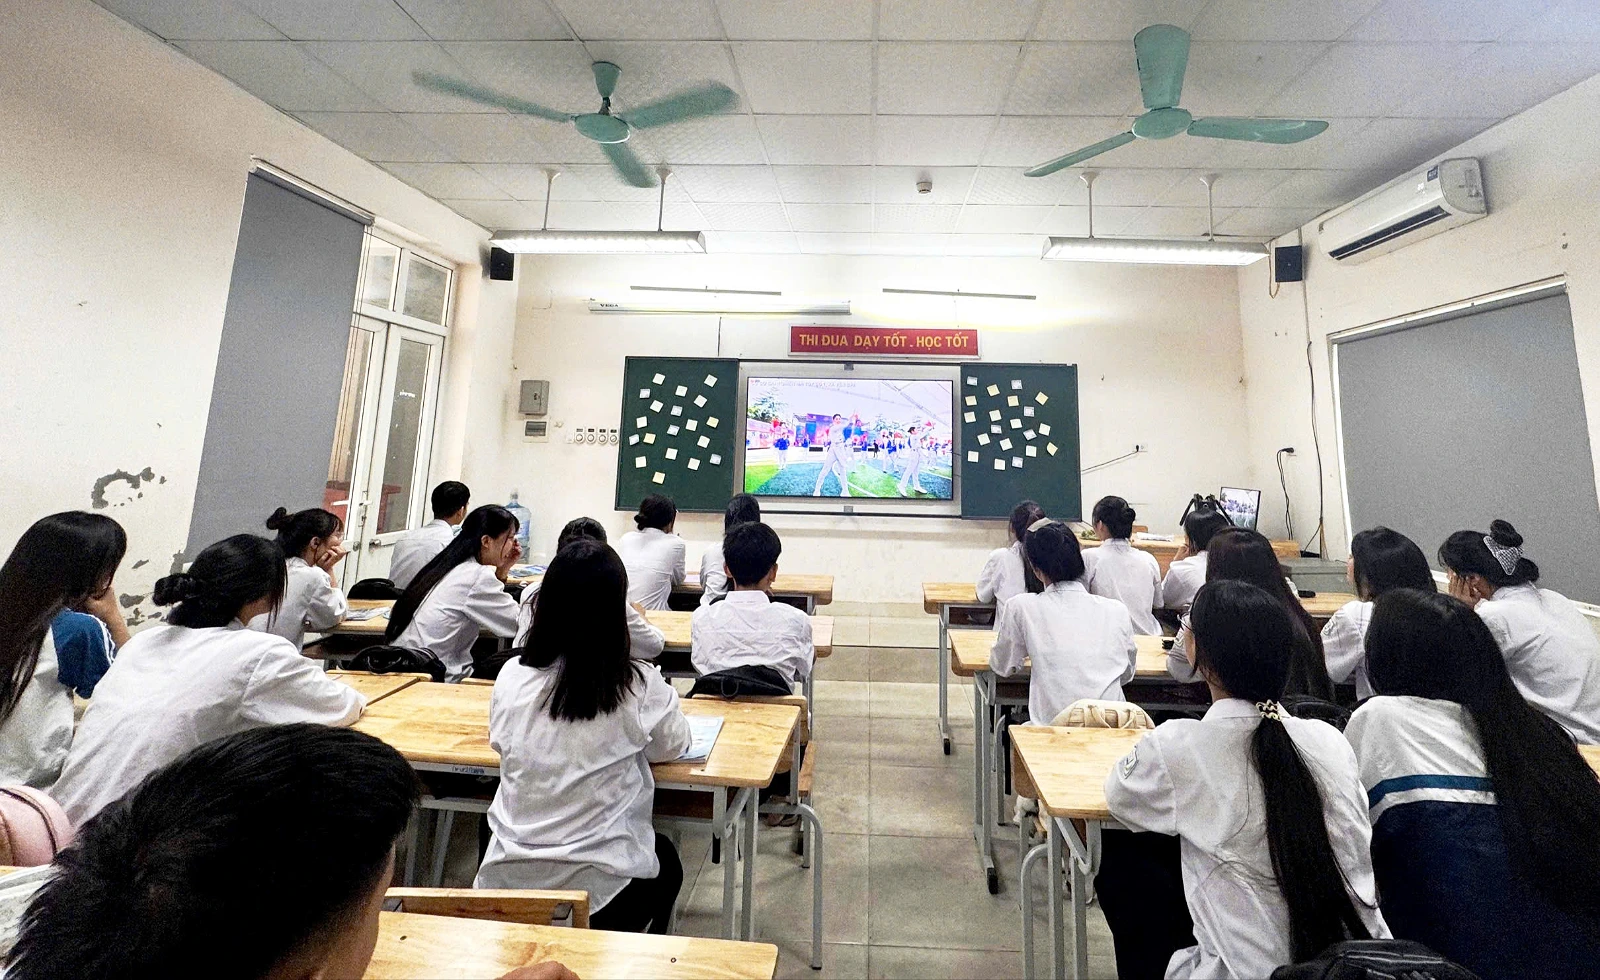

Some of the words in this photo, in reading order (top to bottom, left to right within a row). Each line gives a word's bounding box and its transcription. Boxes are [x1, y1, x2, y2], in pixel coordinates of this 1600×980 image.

[799, 334, 819, 346] THI
[822, 334, 848, 346] ĐUA
[854, 335, 880, 350] DẠY
[916, 336, 942, 350] HỌC
[946, 332, 969, 348] TỐT
